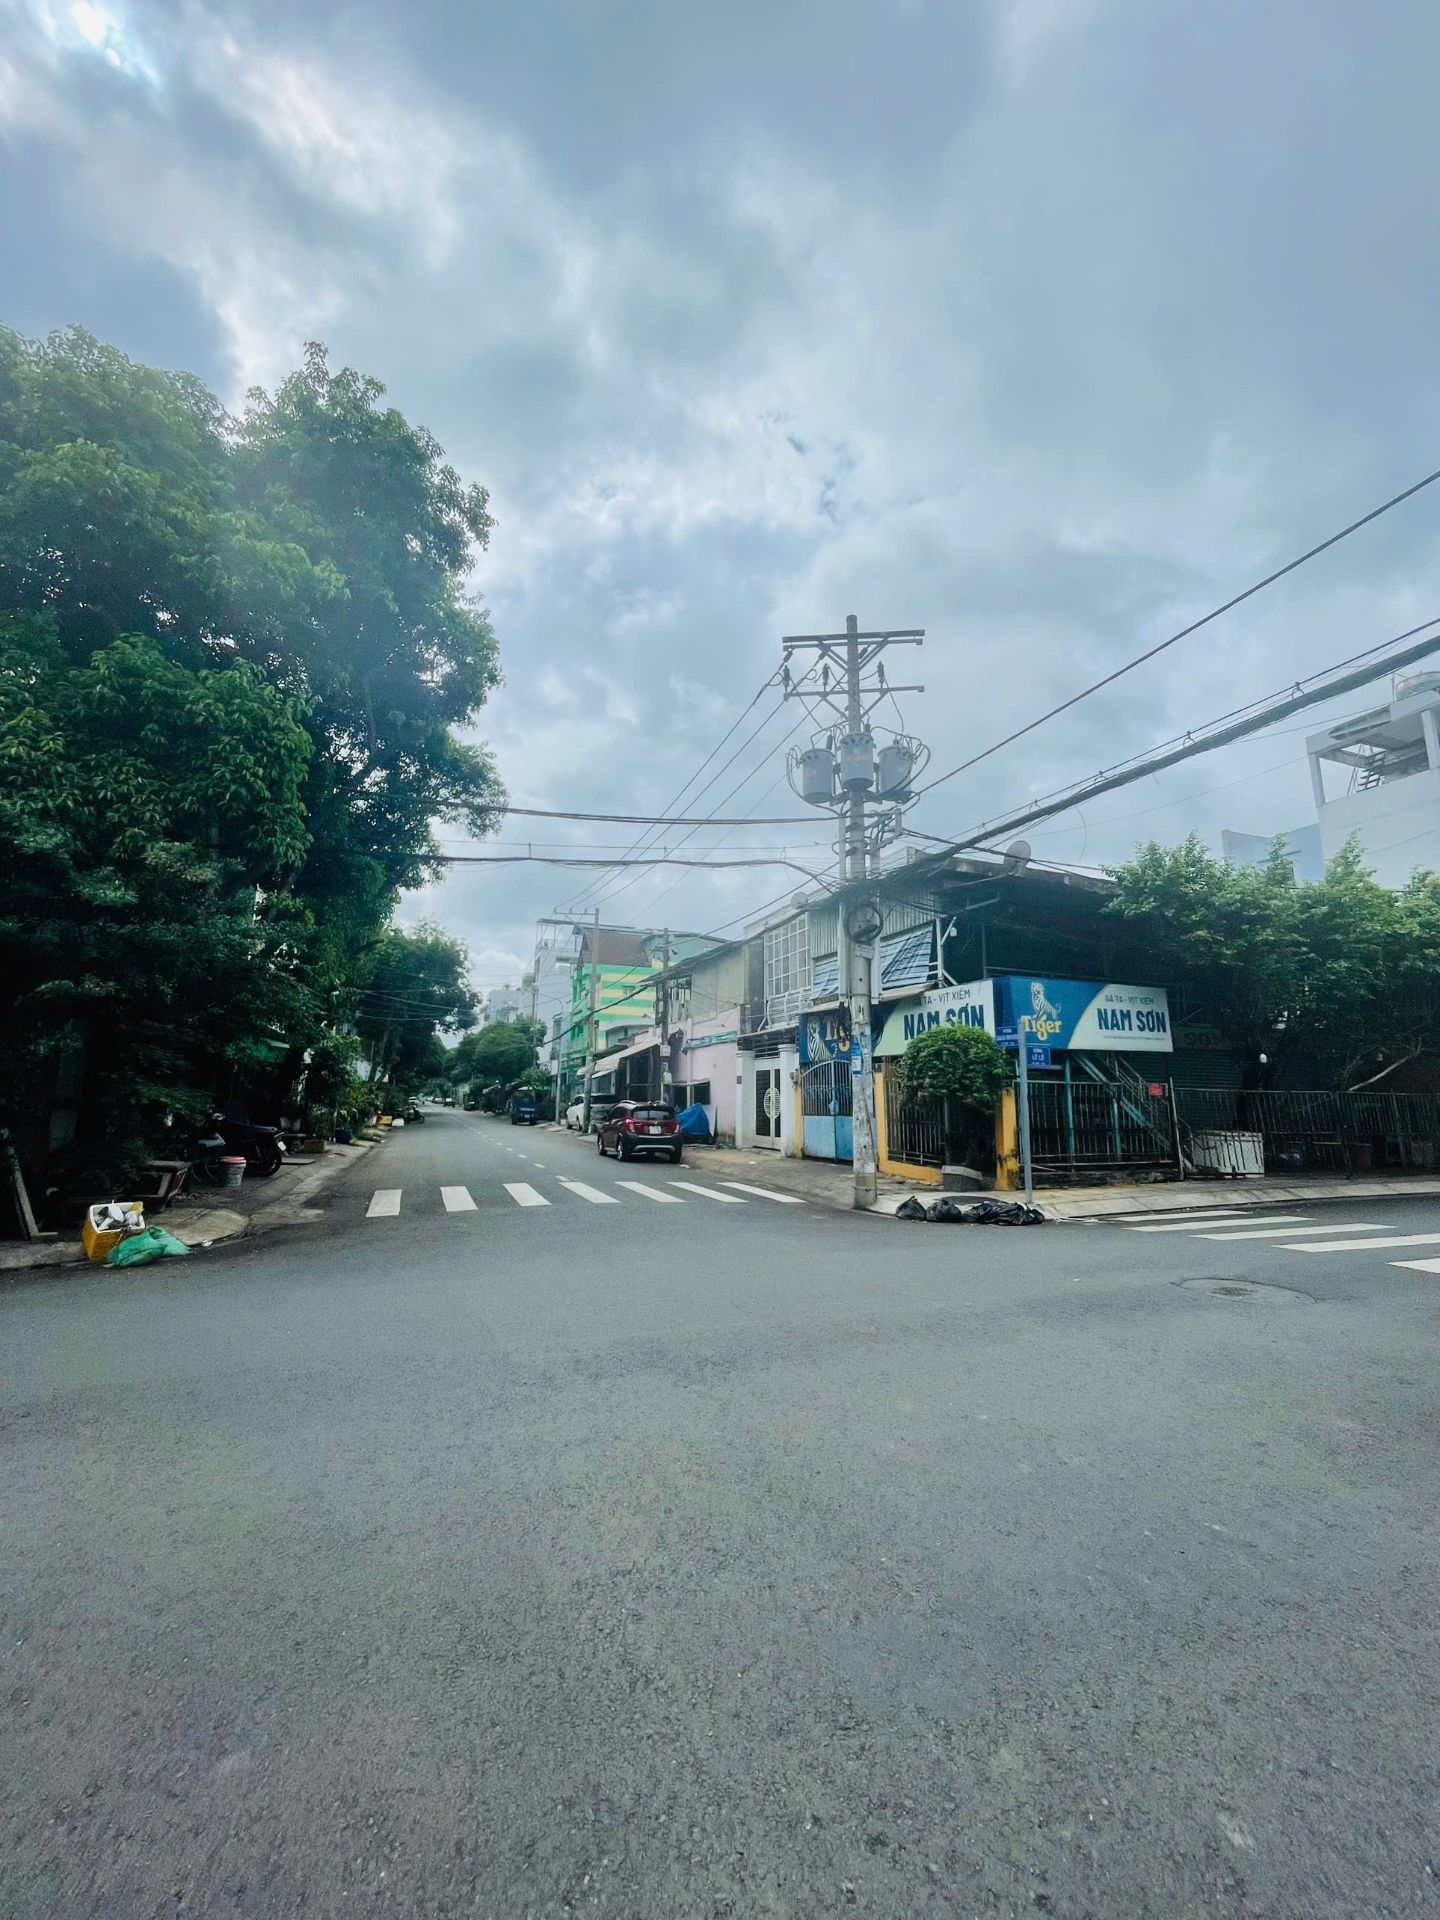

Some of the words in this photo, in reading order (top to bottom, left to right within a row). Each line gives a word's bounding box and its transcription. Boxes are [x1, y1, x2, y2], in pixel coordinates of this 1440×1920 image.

[923, 996, 932, 1005] TA
[904, 1010, 940, 1040] NAM
[1021, 1015, 1062, 1041] Tiger
[1097, 1008, 1132, 1031] NAM
[1136, 1009, 1167, 1033] SƠN
